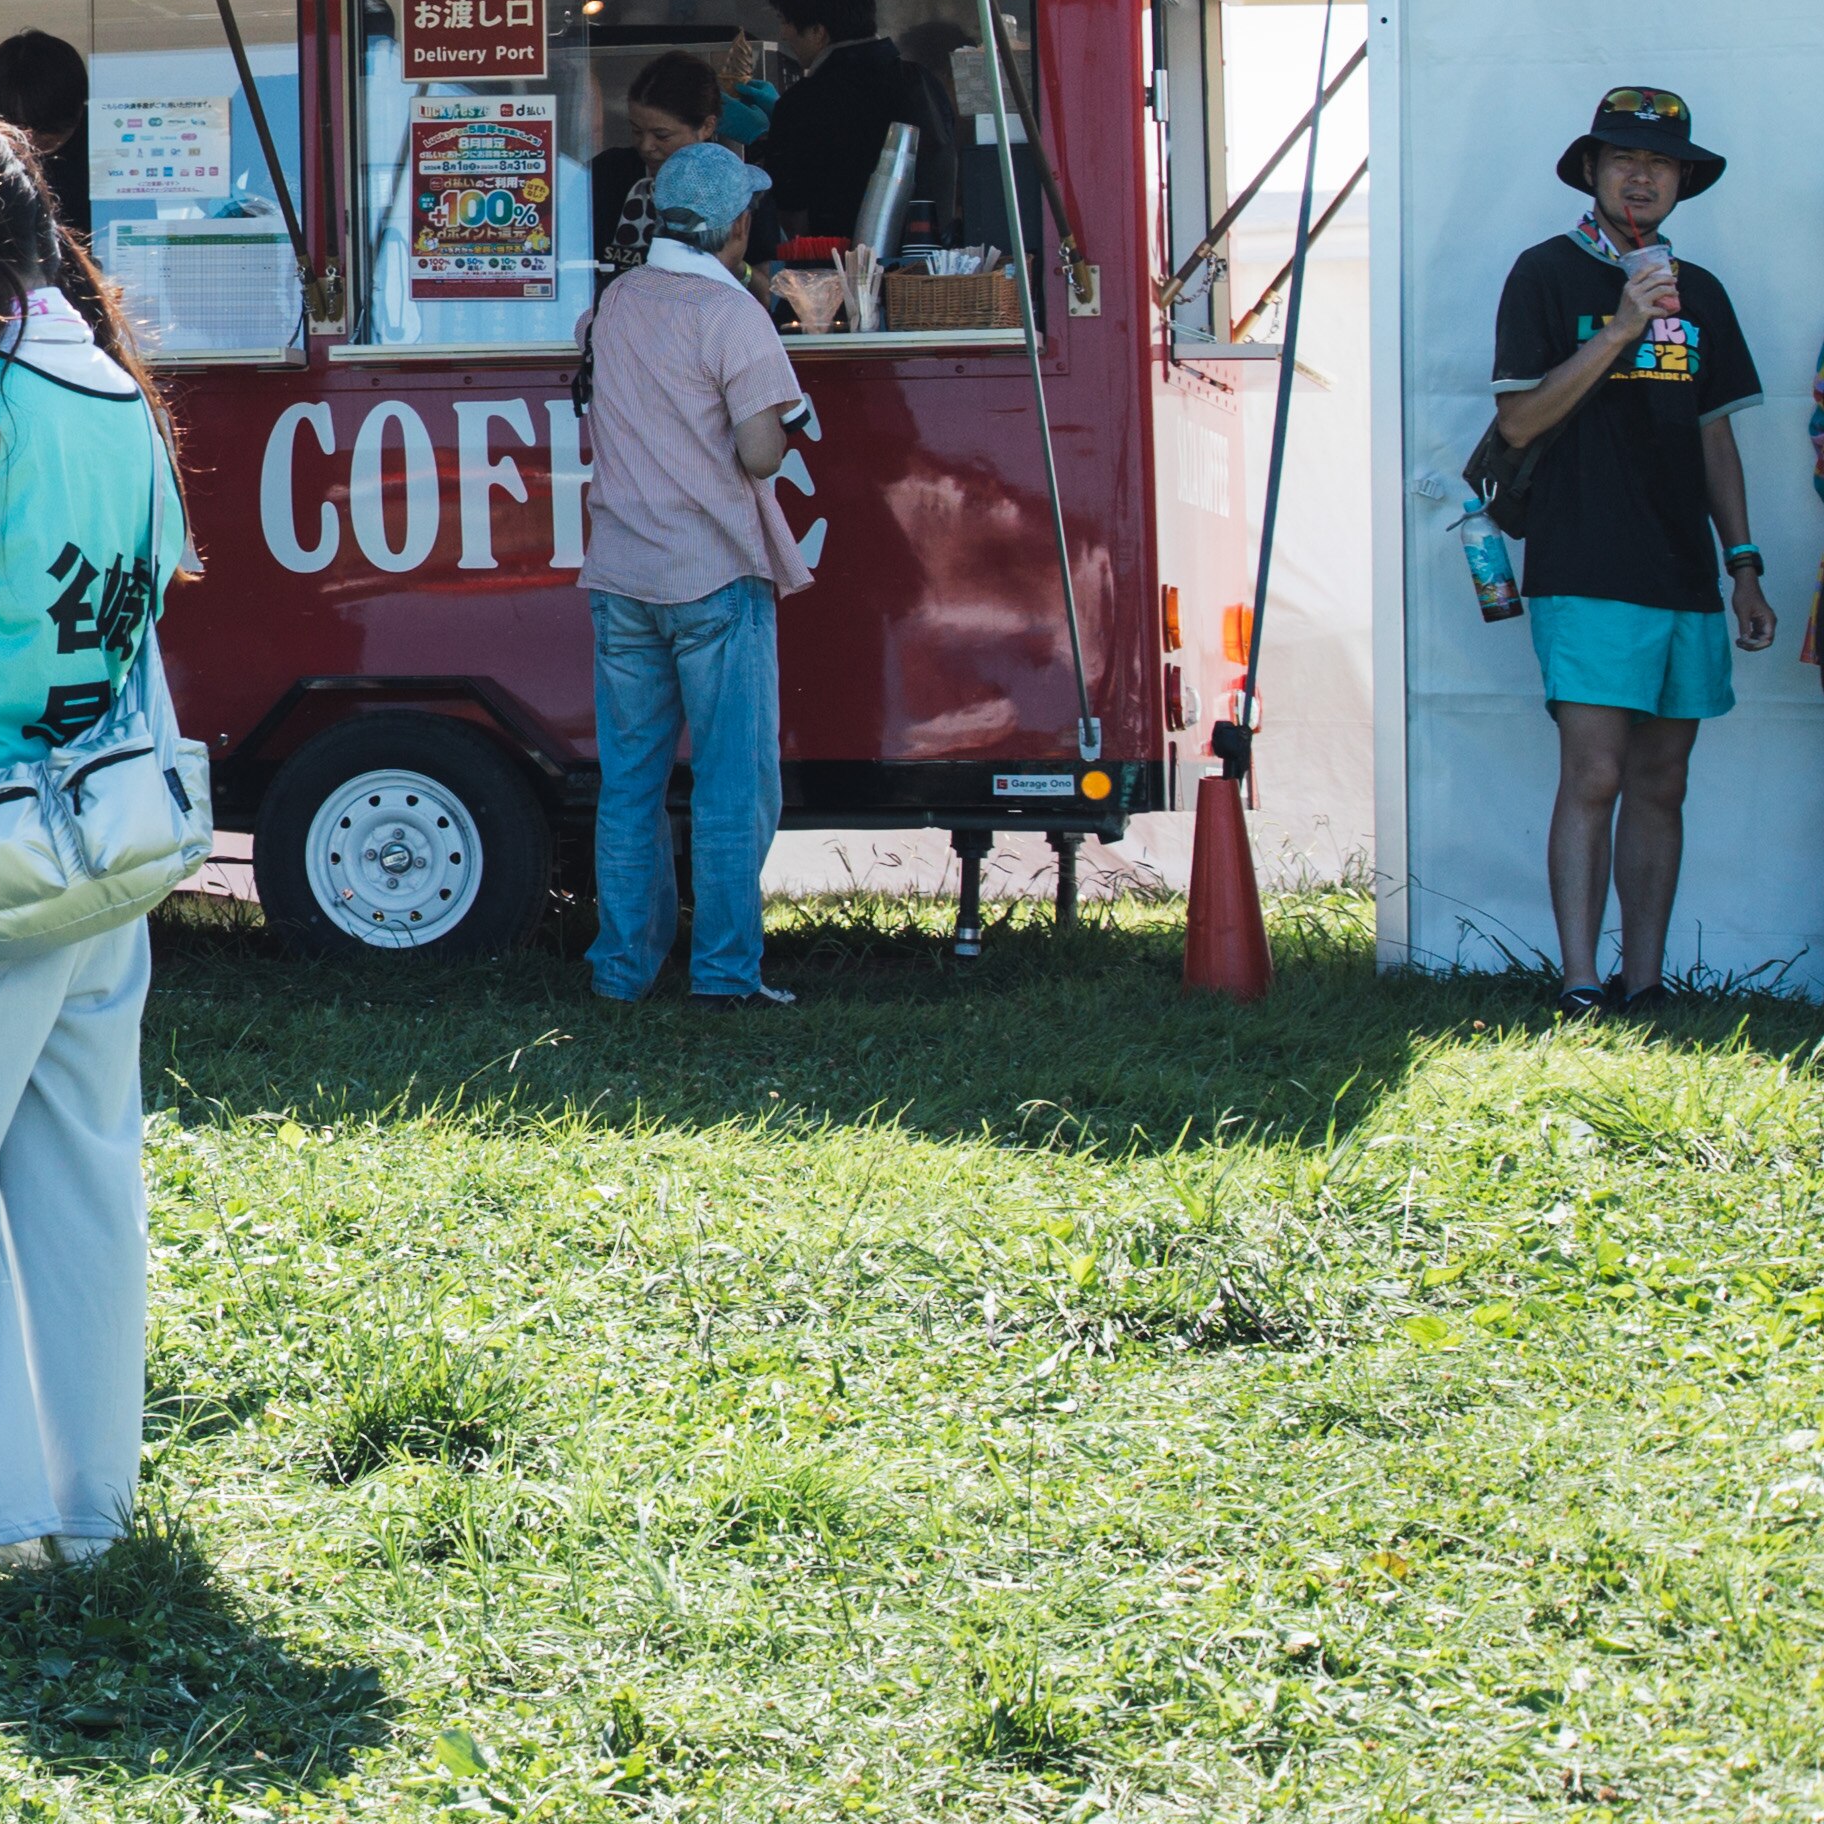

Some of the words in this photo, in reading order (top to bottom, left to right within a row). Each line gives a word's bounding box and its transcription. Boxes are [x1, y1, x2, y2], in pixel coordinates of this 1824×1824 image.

[413, 45, 486, 64] Delivery
[495, 43, 535, 61] Port
[604, 246, 642, 266] SAZA
[1012, 779, 1047, 789] Garage
[1050, 779, 1072, 787] Ono
